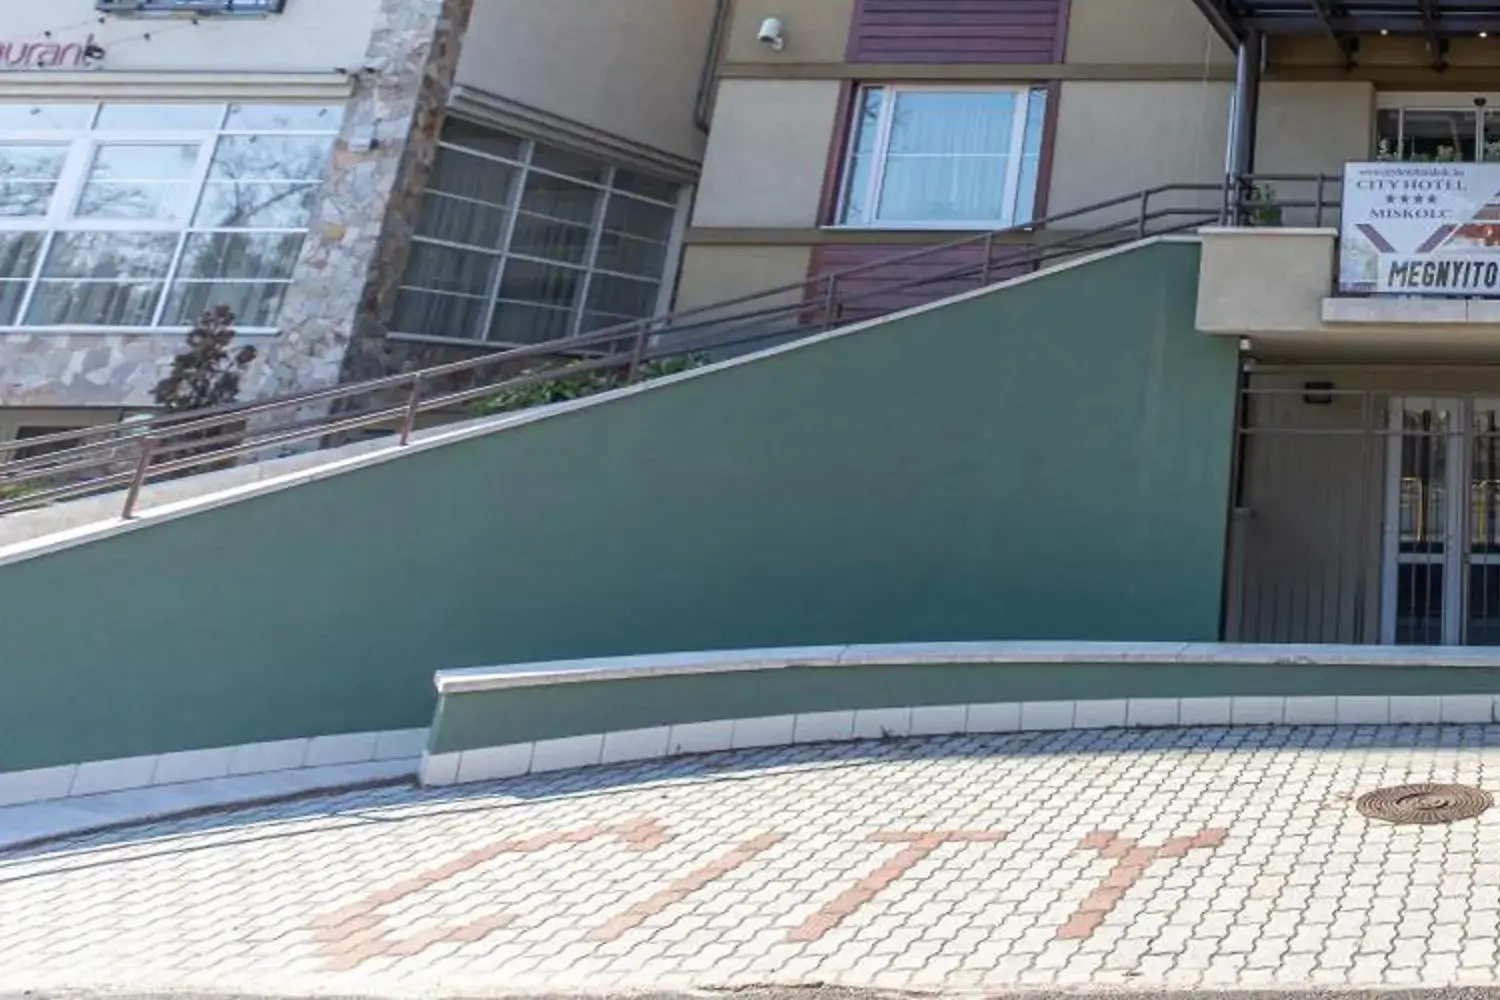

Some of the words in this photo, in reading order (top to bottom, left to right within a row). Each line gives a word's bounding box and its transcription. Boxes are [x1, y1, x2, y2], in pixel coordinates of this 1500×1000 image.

[0, 33, 93, 66] urant
[1356, 179, 1399, 191] CITY
[1404, 179, 1467, 191] HOTEL
[1370, 208, 1454, 219] MISKOLC
[309, 818, 1226, 970] CITY
